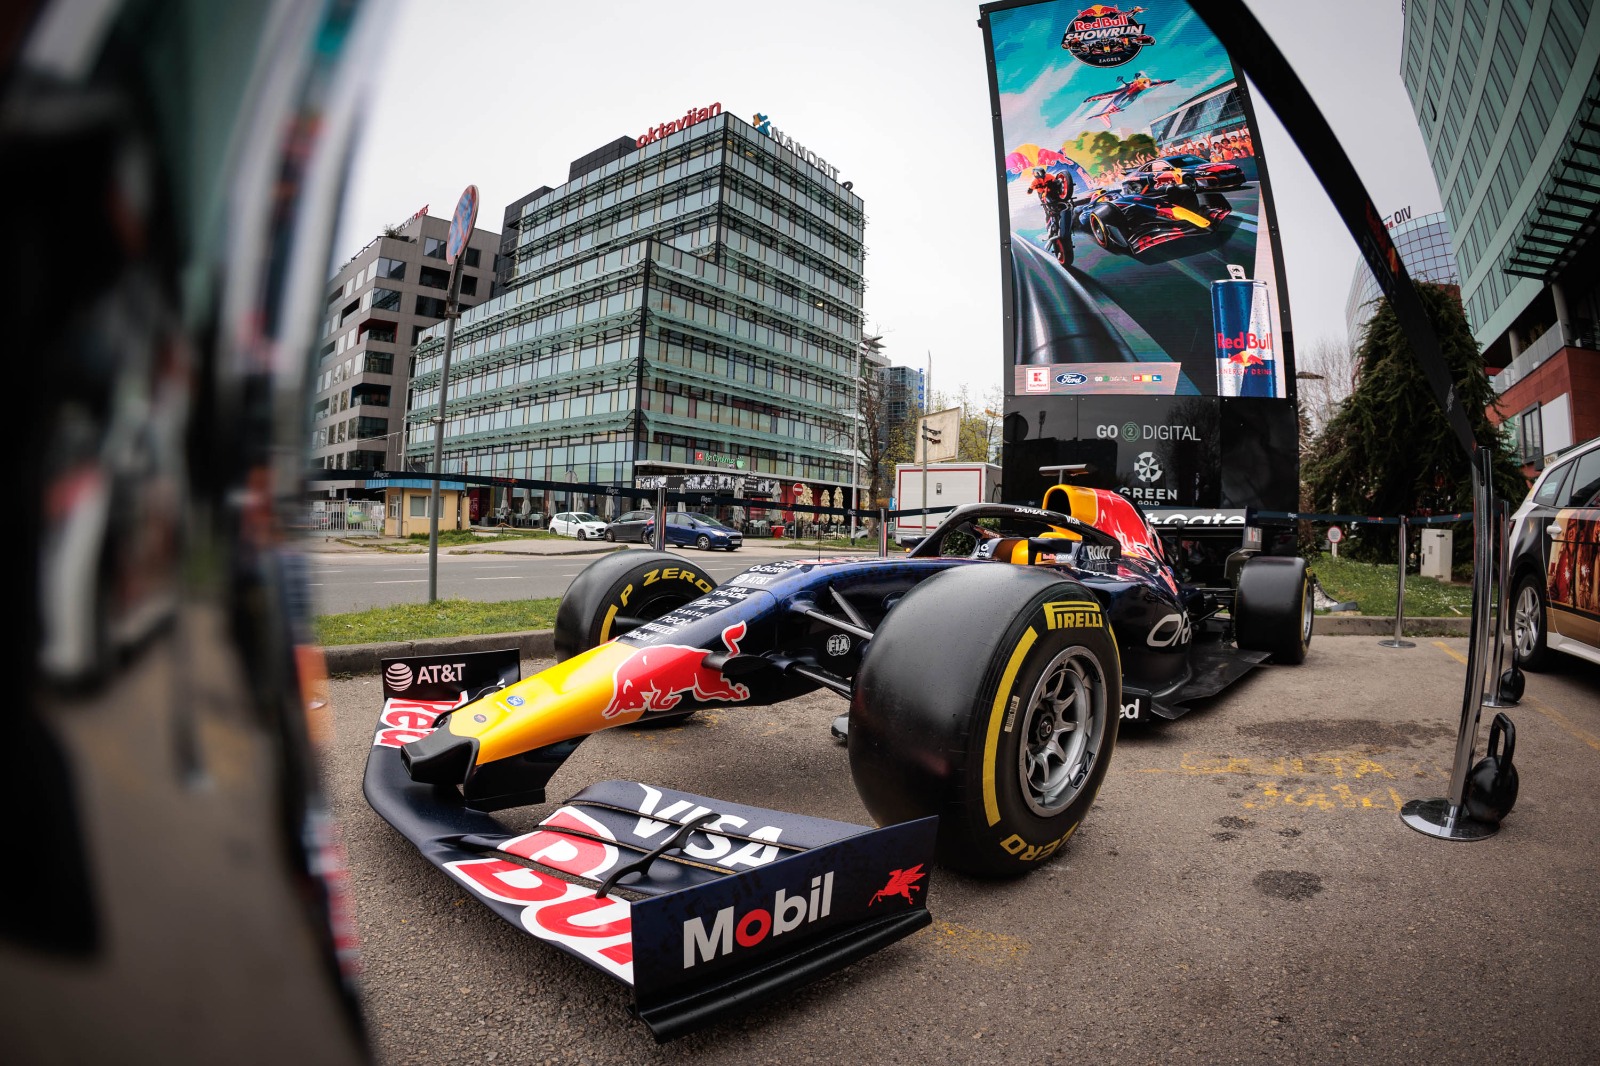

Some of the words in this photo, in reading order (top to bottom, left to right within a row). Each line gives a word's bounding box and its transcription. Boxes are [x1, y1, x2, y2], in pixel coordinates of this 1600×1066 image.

[1074, 19, 1100, 30] Red
[1101, 15, 1128, 27] Bull
[1064, 25, 1144, 42] SHOWRUN
[636, 102, 722, 148] oktavijan
[771, 126, 841, 181] NANOBIT
[1394, 206, 1411, 224] OIV
[1217, 332, 1244, 349] Red
[1247, 333, 1273, 350] Bull
[1062, 374, 1082, 384] Ford
[1096, 424, 1119, 439] GO
[1143, 425, 1202, 441] DIGITAL
[1120, 487, 1178, 500] GREEN
[1014, 507, 1049, 517] DAMAC
[1066, 515, 1081, 526] VISA
[643, 567, 713, 594] ZERO
[748, 576, 774, 585] AT&T
[1043, 600, 1103, 630] PIRELLI
[829, 640, 848, 651] FIA
[417, 663, 466, 684] AT&T
[633, 783, 783, 868] VISA
[683, 871, 835, 969] Mobil
